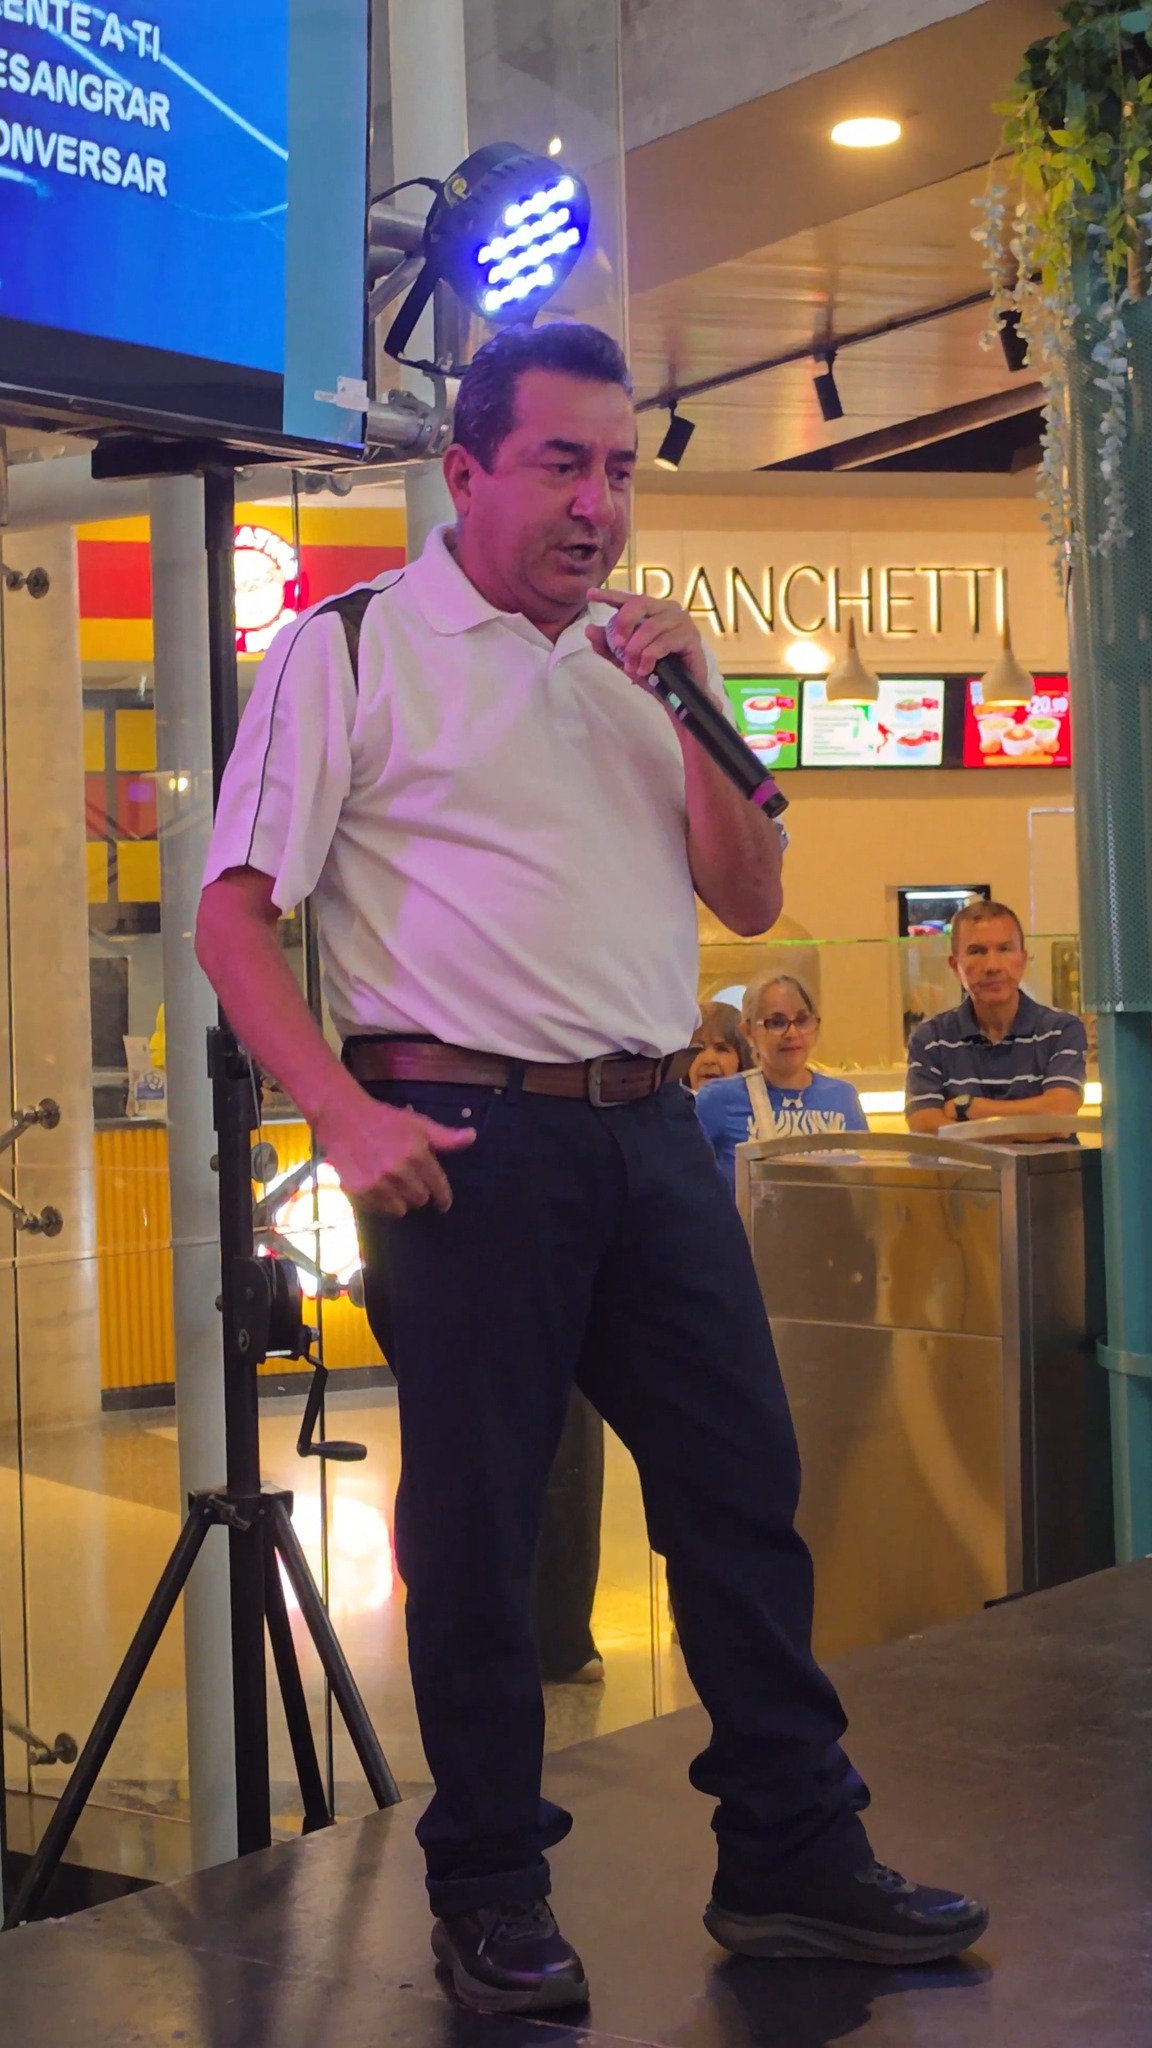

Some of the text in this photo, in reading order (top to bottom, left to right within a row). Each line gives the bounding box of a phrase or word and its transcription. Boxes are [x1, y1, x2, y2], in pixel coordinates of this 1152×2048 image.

[0, 0, 160, 62] ENTE A TI
[604, 565, 1009, 635] RANCHETTI
